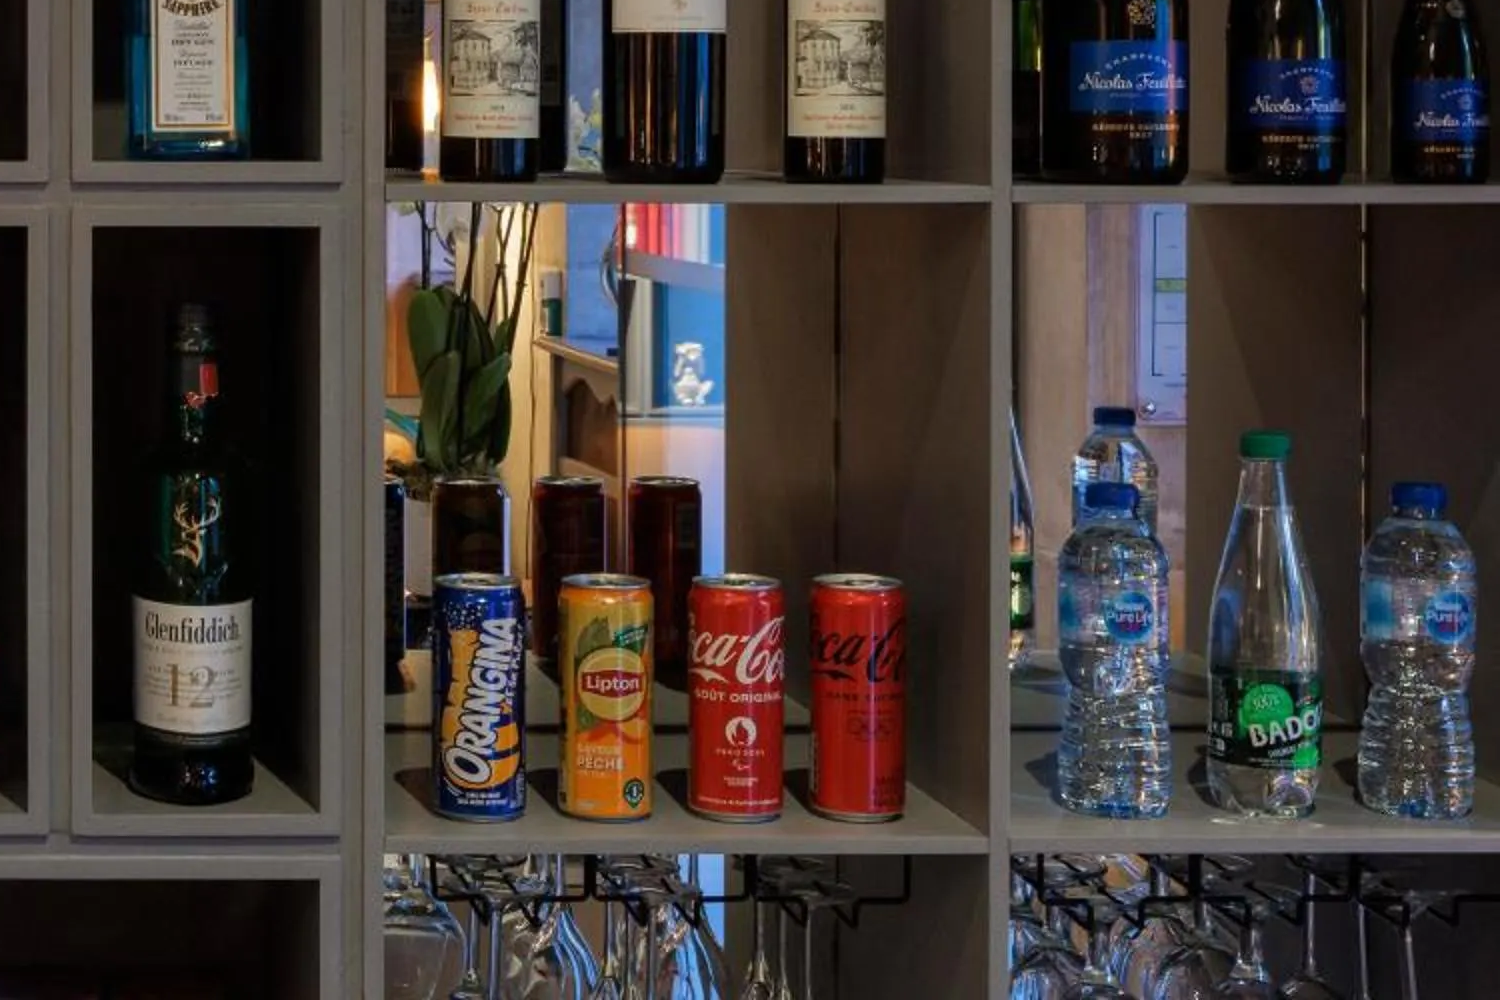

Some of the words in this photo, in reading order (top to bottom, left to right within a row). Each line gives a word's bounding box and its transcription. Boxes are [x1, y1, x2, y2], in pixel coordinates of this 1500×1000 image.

[1078, 72, 1132, 91] Nicolas
[1248, 94, 1301, 114] Nicolas
[1413, 111, 1460, 130] Nicolas
[145, 611, 242, 645] Glenfiddich
[167, 663, 215, 709] 12
[586, 674, 641, 694] Lipton
[444, 617, 517, 784] ORANGINA
